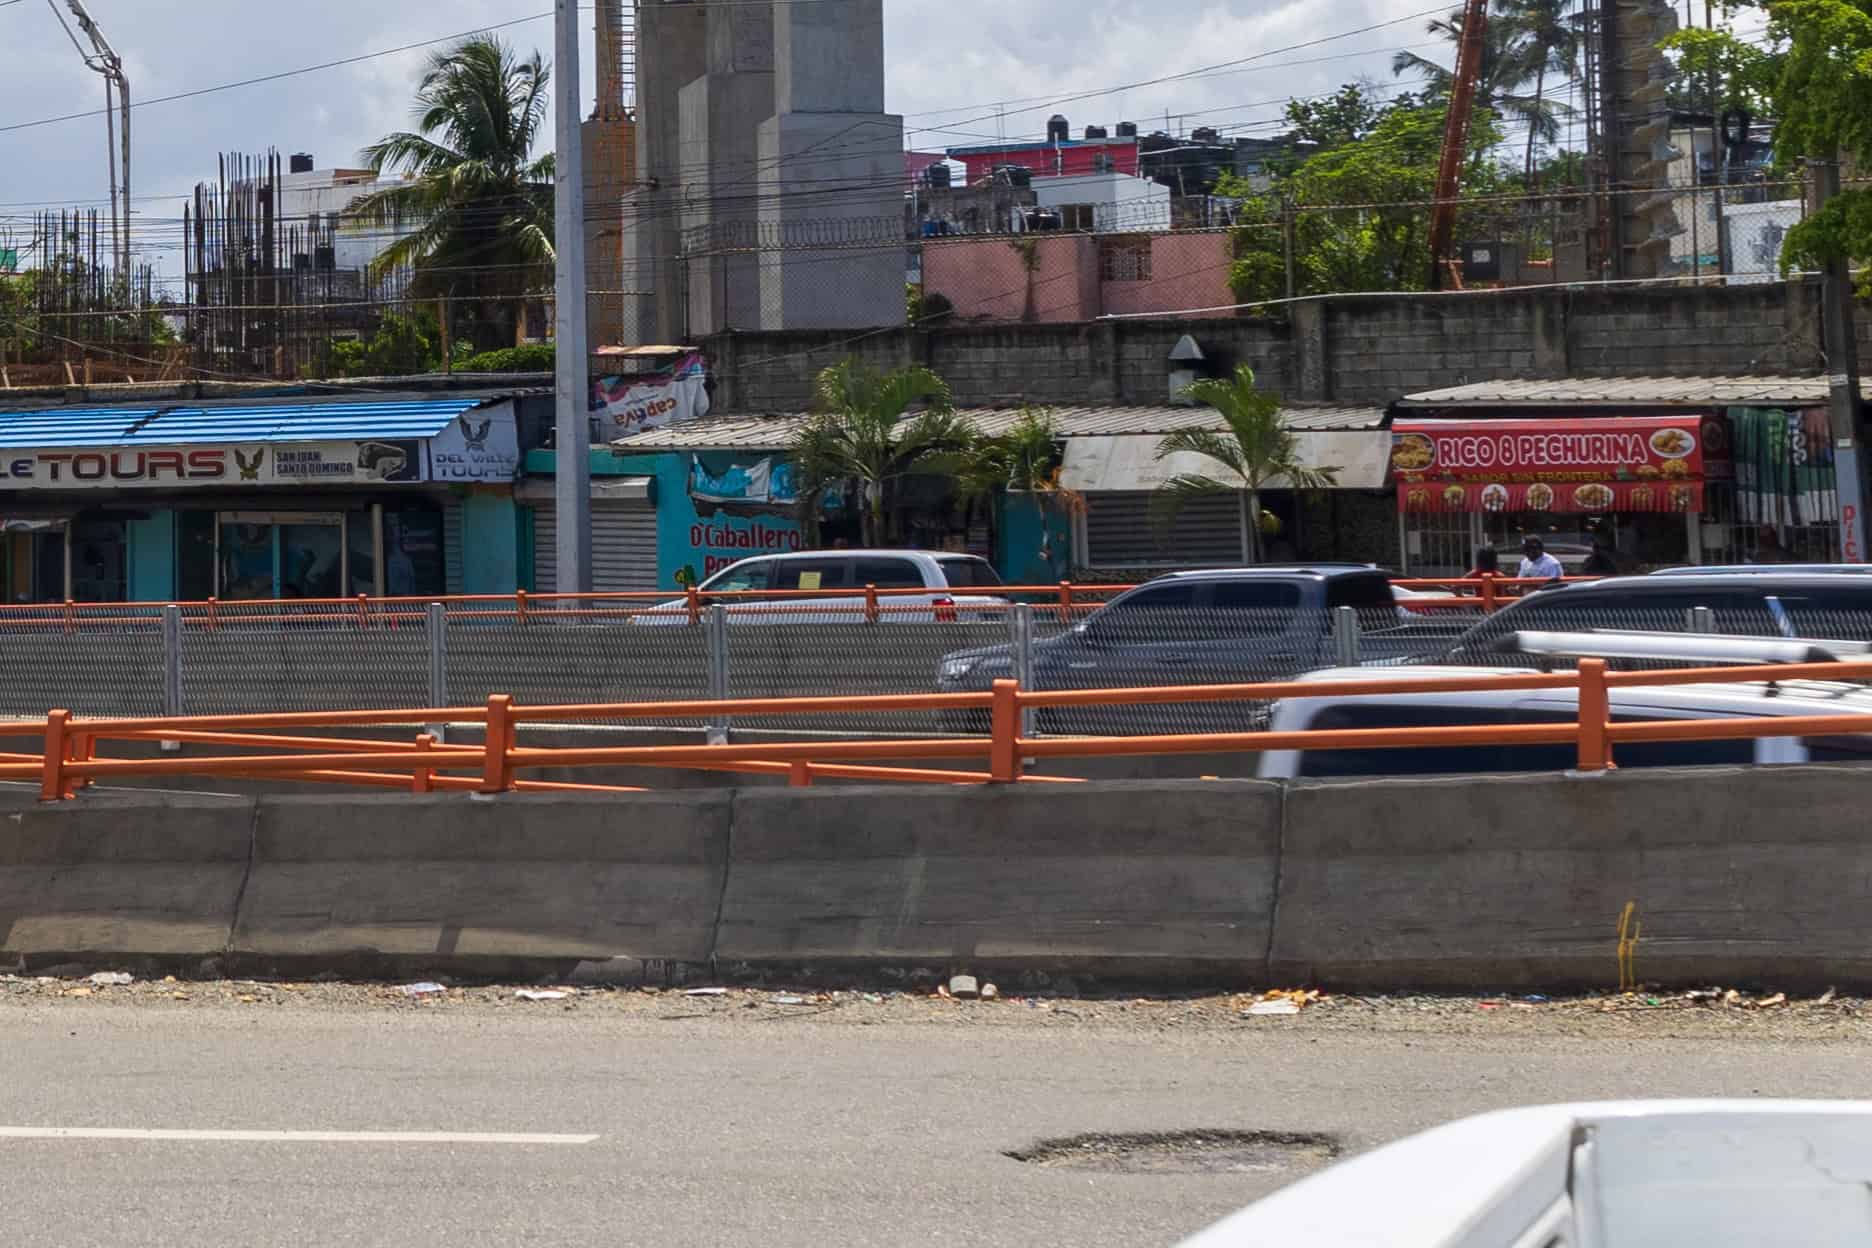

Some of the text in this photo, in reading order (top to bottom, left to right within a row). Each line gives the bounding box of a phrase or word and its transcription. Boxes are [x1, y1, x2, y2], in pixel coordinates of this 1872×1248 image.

[436, 454, 465, 464] DEL
[1437, 436, 1495, 467] RICO
[1519, 433, 1649, 466] PECHURINA
[38, 450, 225, 481] TOURS
[276, 462, 353, 474] SANTO DOMINGO
